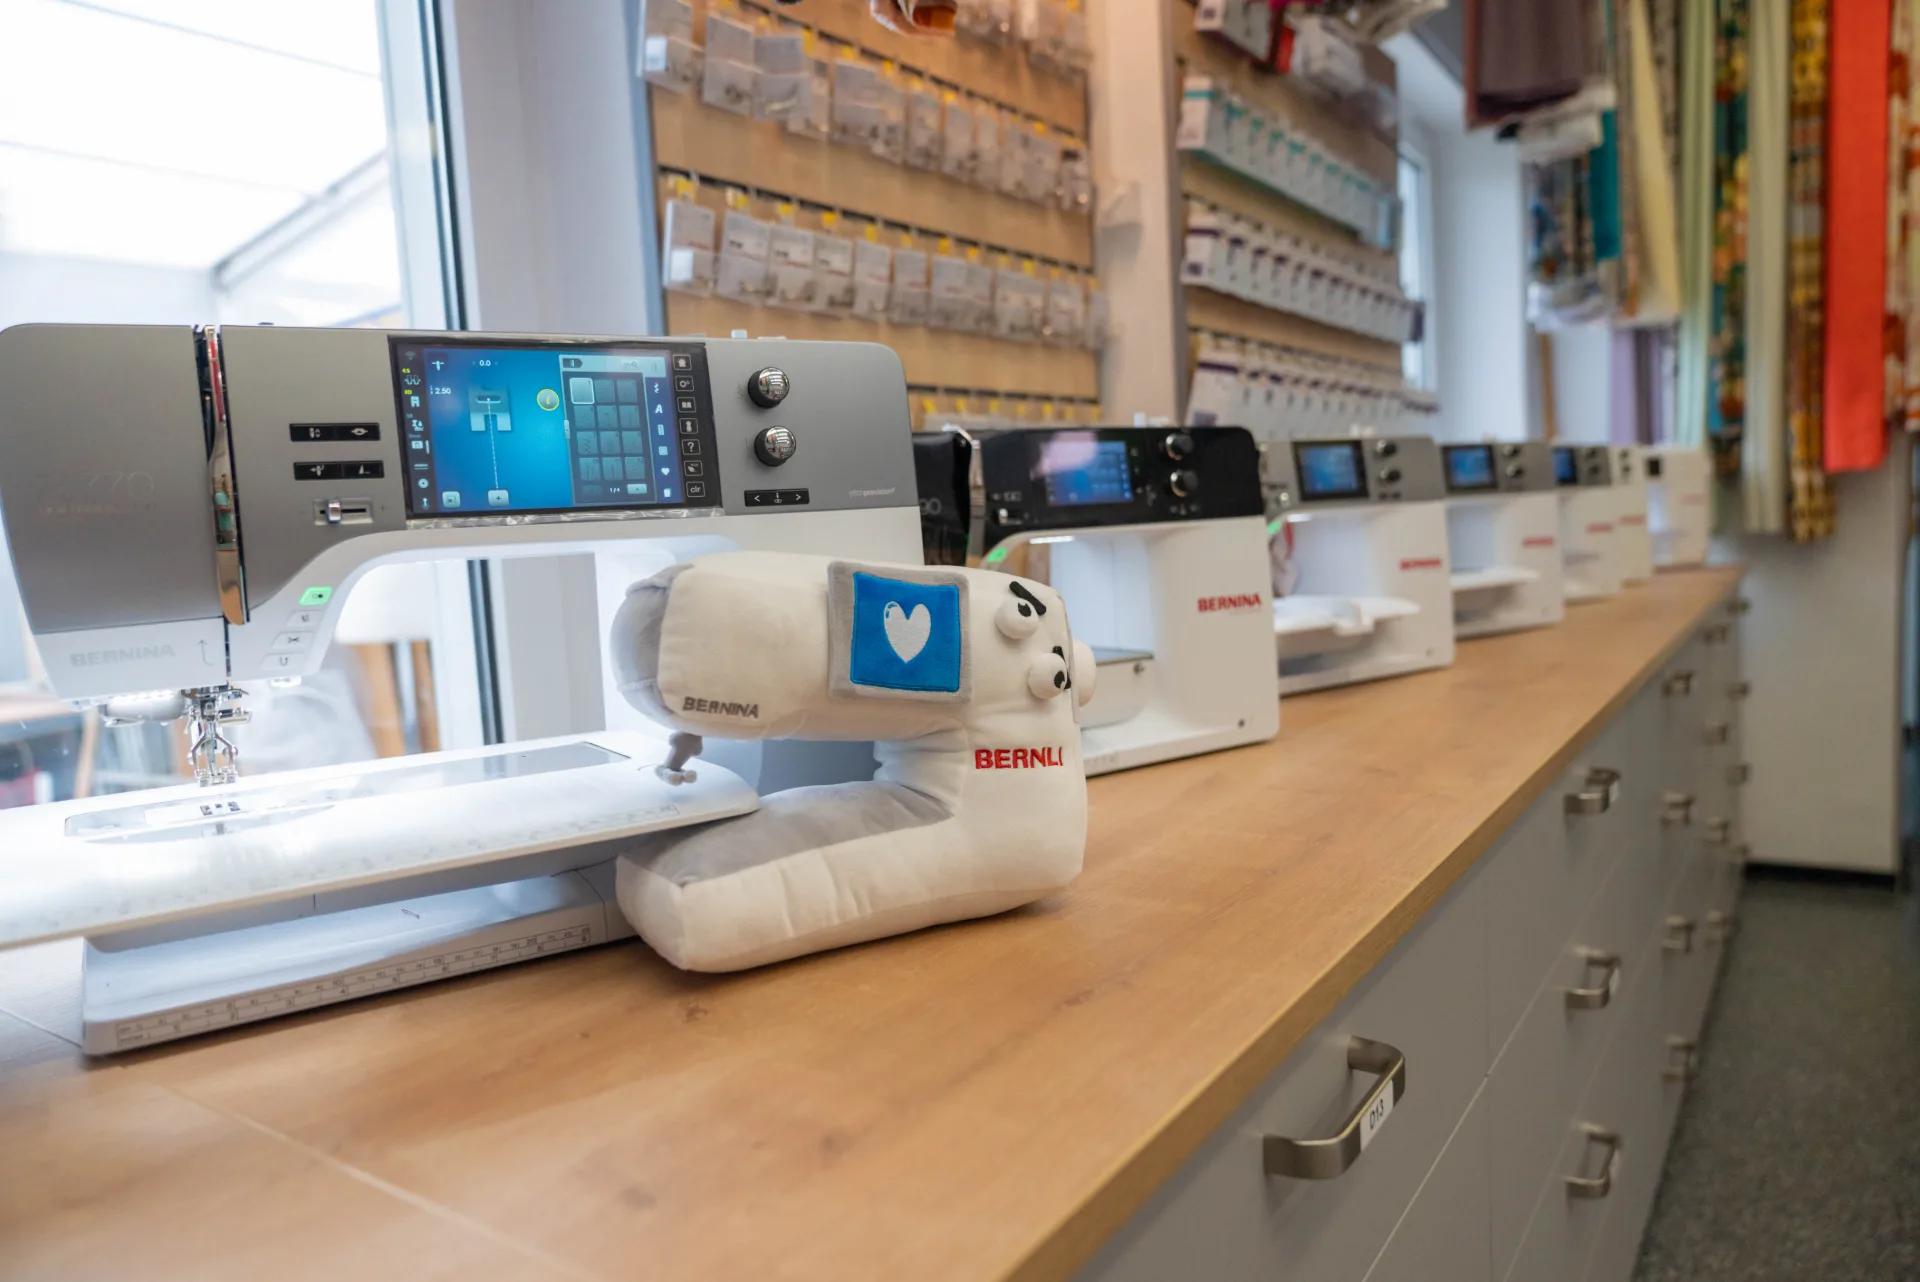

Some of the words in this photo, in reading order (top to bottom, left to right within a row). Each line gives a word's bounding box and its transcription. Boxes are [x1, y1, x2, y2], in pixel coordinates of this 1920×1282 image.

[479, 359, 491, 367] 0.0
[434, 387, 452, 395] 2.50
[690, 485, 701, 493] clr
[1197, 591, 1262, 613] BERNINA
[70, 644, 176, 668] BERNINA
[682, 695, 760, 719] BERNINA
[975, 746, 1064, 770] BERNLI
